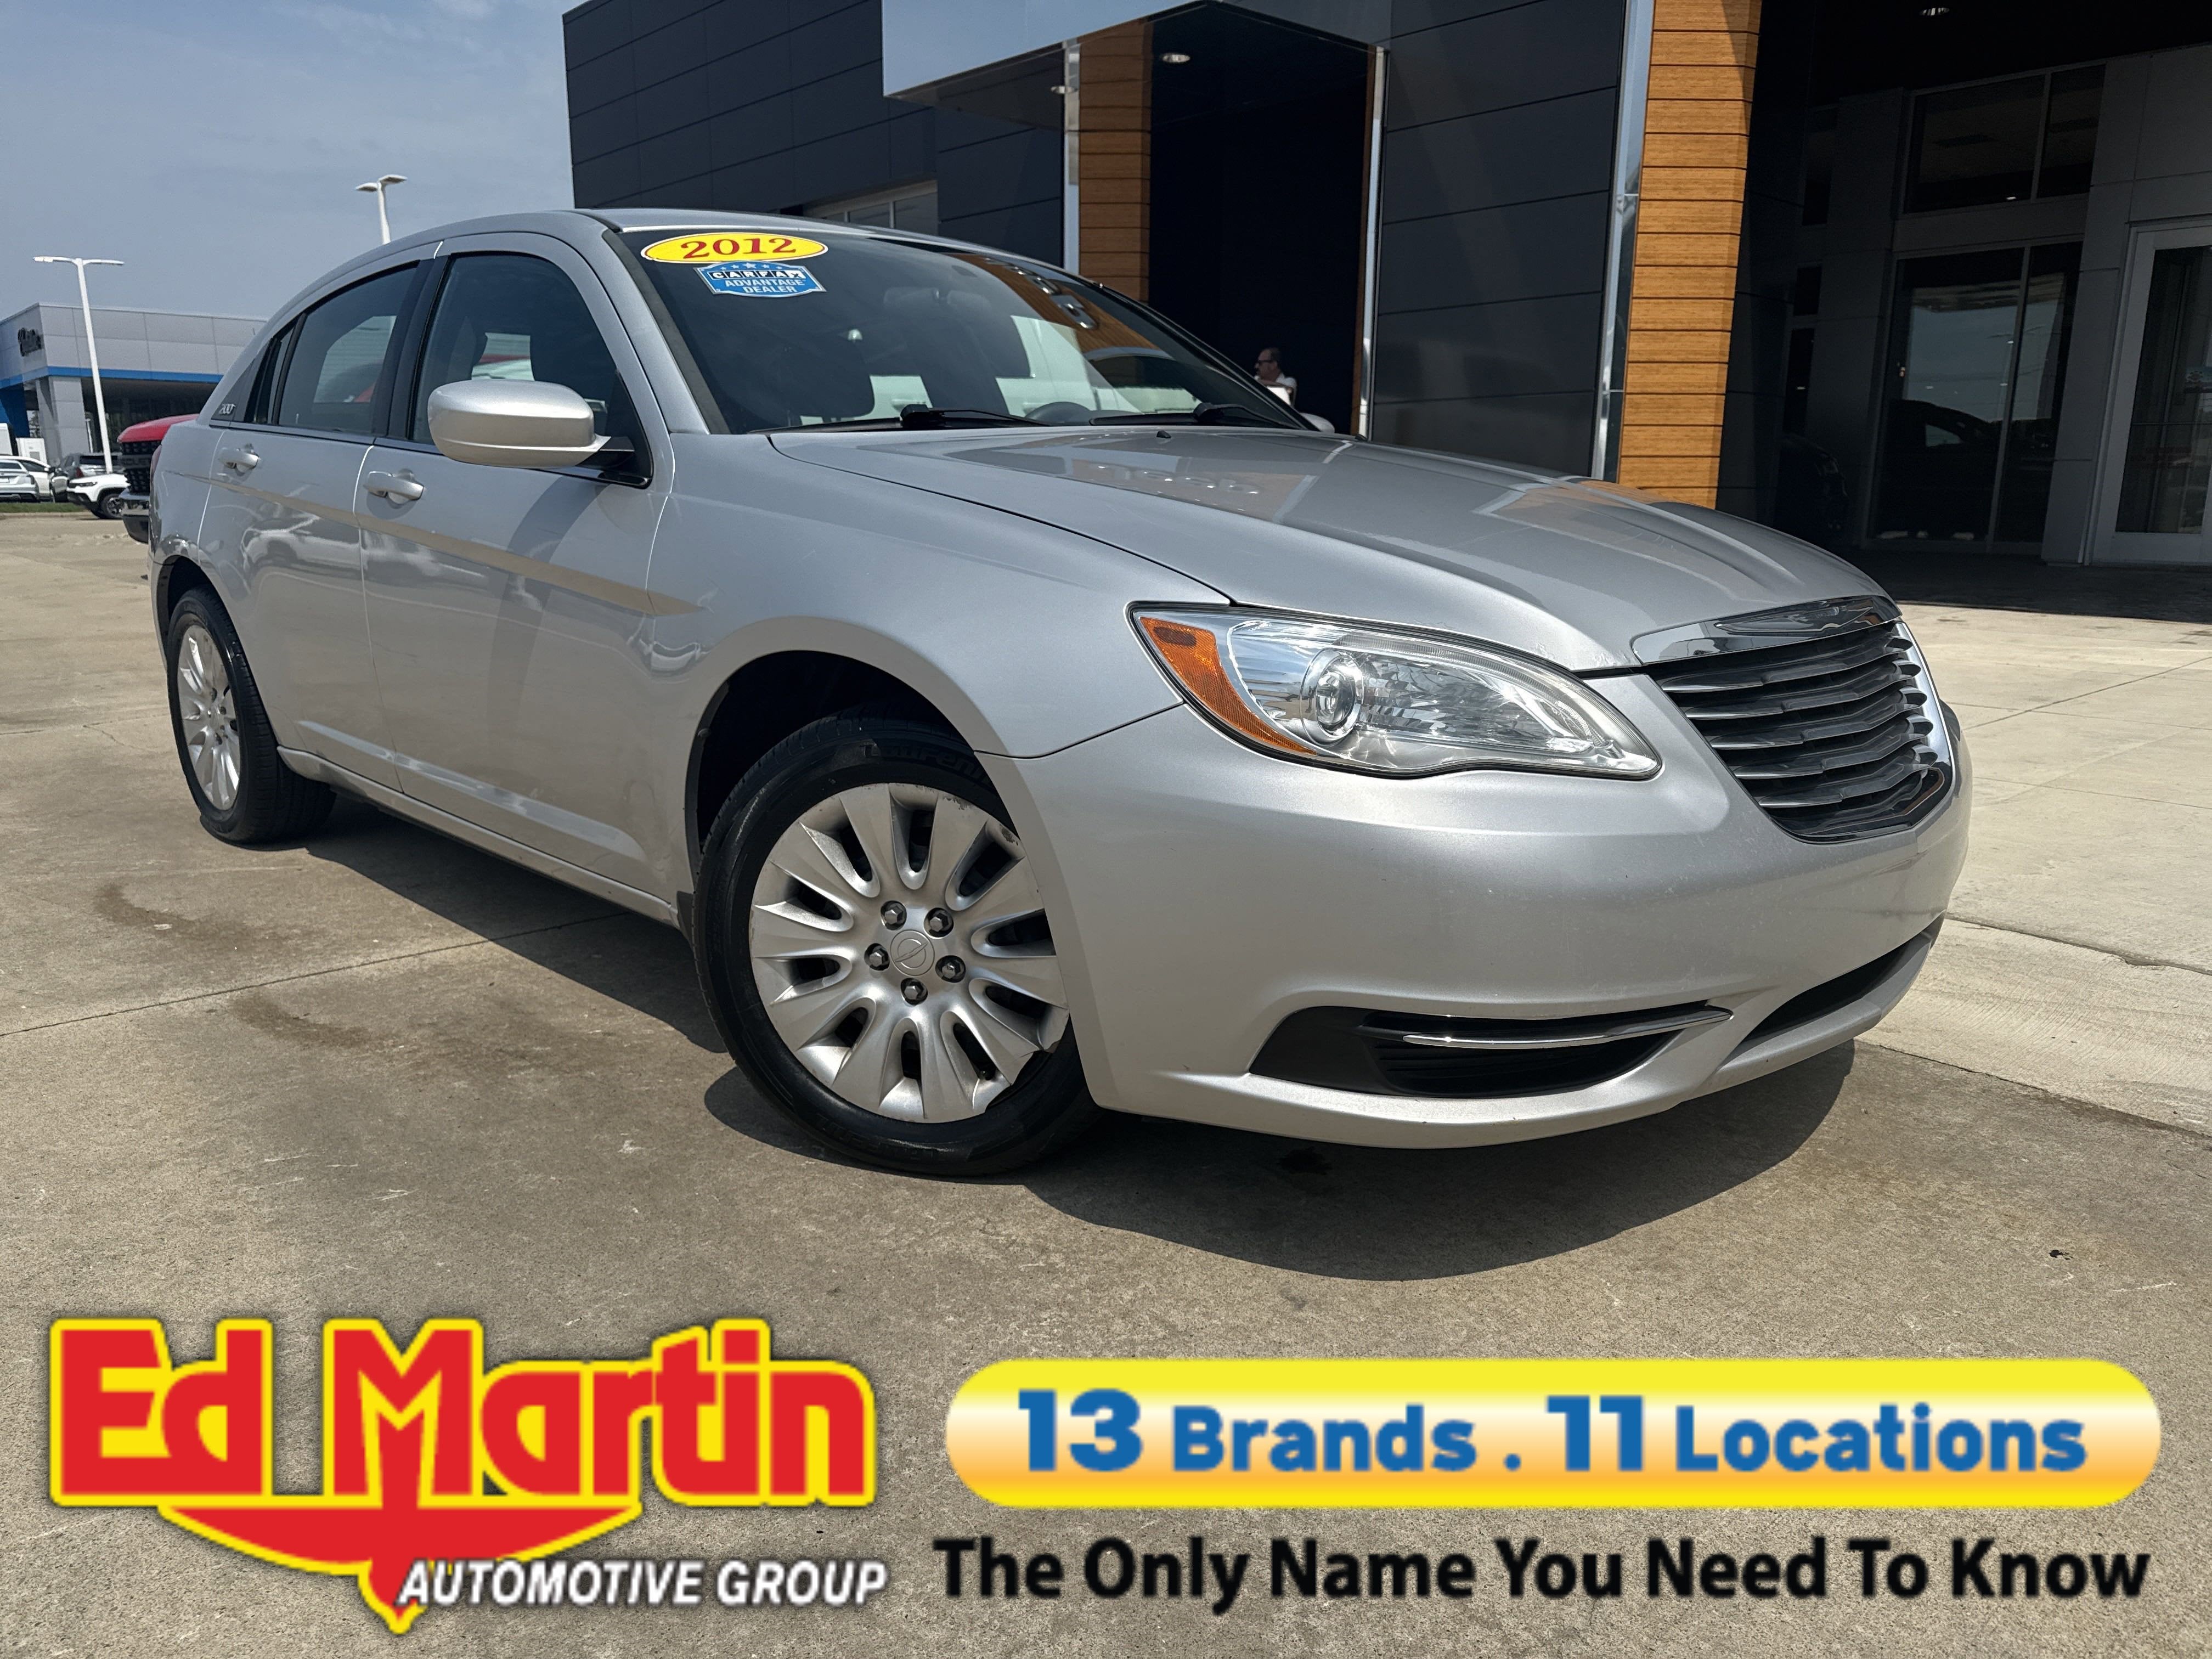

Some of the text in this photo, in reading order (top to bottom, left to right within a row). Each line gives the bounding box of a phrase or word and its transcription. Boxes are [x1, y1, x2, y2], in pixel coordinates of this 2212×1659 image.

[680, 238, 797, 259] 2012
[711, 270, 806, 279] CARFAX
[725, 279, 805, 287] ADVANTAGE
